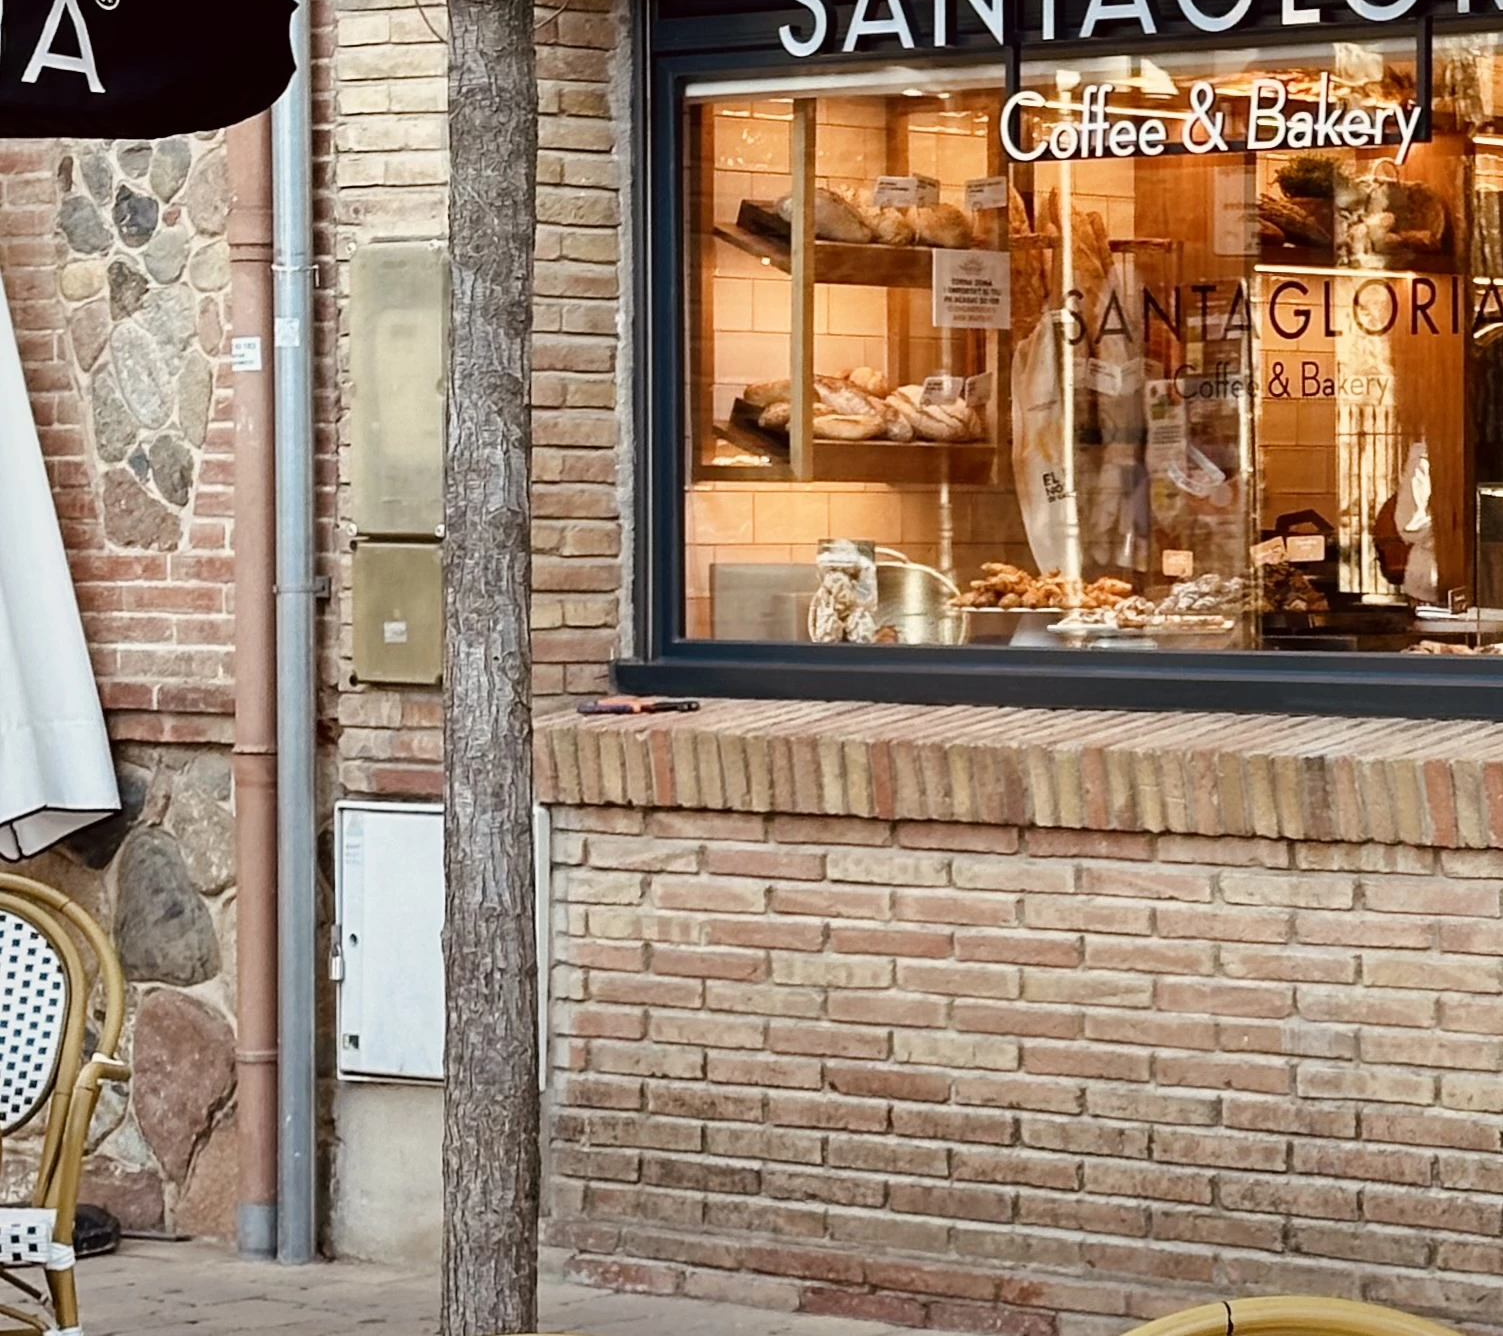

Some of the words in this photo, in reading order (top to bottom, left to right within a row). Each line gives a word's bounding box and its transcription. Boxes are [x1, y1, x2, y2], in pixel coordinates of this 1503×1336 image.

[999, 82, 1167, 163] Coffee
[1181, 79, 1229, 156] &
[1246, 72, 1422, 165] Bakery
[1173, 359, 1259, 401] Coffee
[1267, 361, 1291, 399] &
[1301, 360, 1390, 408] Bakery
